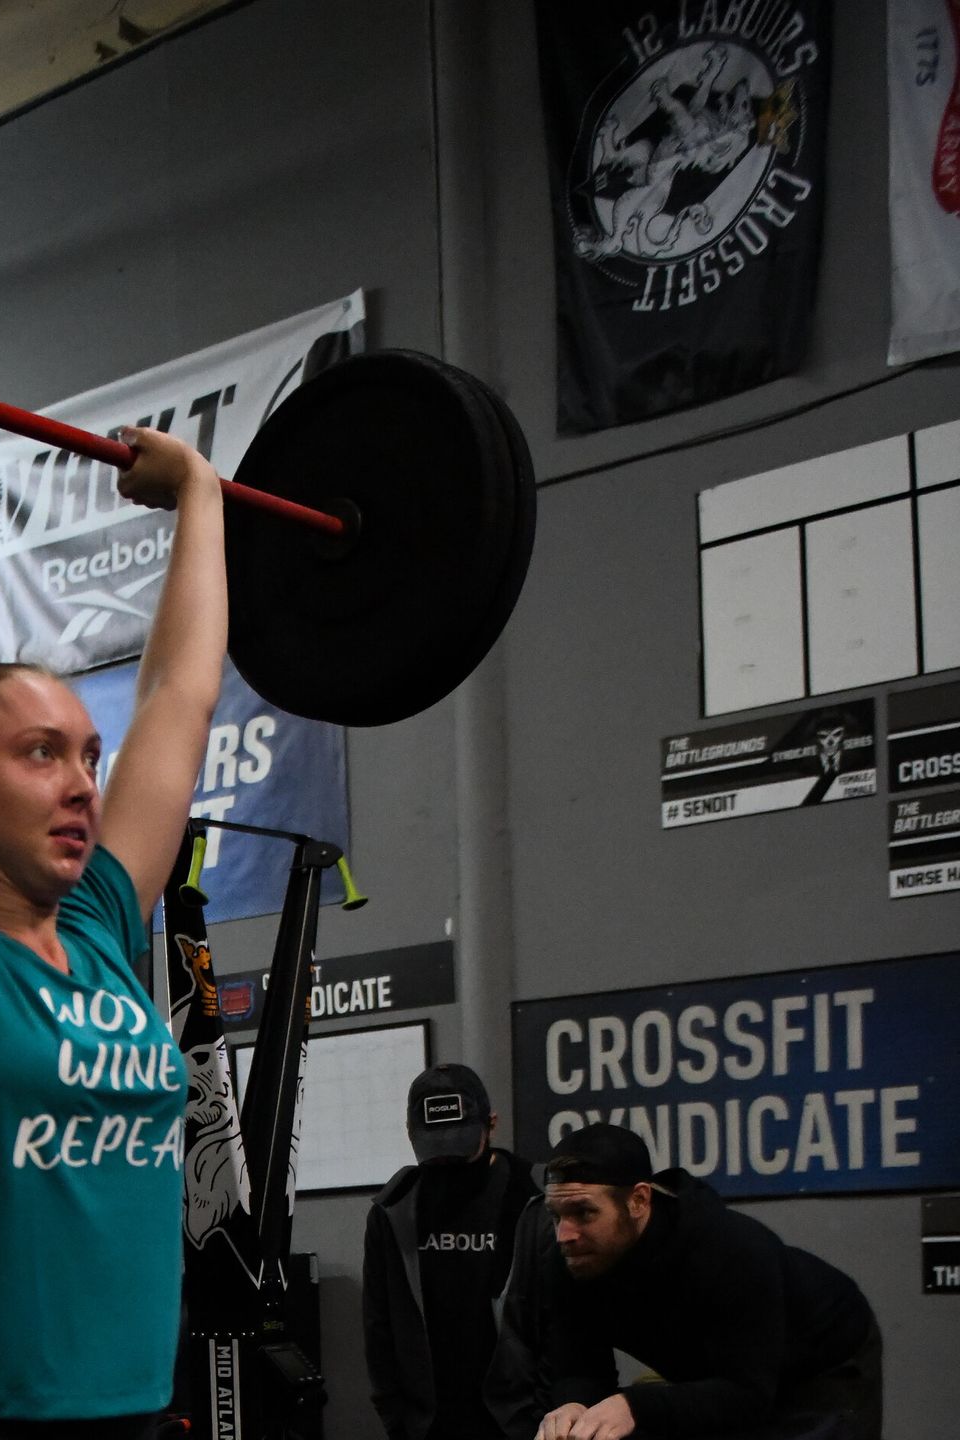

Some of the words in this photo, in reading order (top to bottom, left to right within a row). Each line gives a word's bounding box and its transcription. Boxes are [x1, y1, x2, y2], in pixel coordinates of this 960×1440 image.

[622, 13, 664, 64] 12
[677, 0, 818, 77] LABOURS
[633, 167, 812, 311] CROSSFIT
[666, 736, 768, 768] BATTLEGROUNDS
[669, 737, 689, 752] THE
[897, 800, 920, 816] THE
[897, 868, 943, 890] NORSE
[546, 988, 875, 1095] CROSSFIT
[58, 1039, 181, 1091] WINE
[428, 1103, 458, 1114] ROGUE
[13, 1114, 185, 1171] REPEA
[548, 1084, 921, 1178] SNDICATE
[216, 1345, 233, 1378] MID
